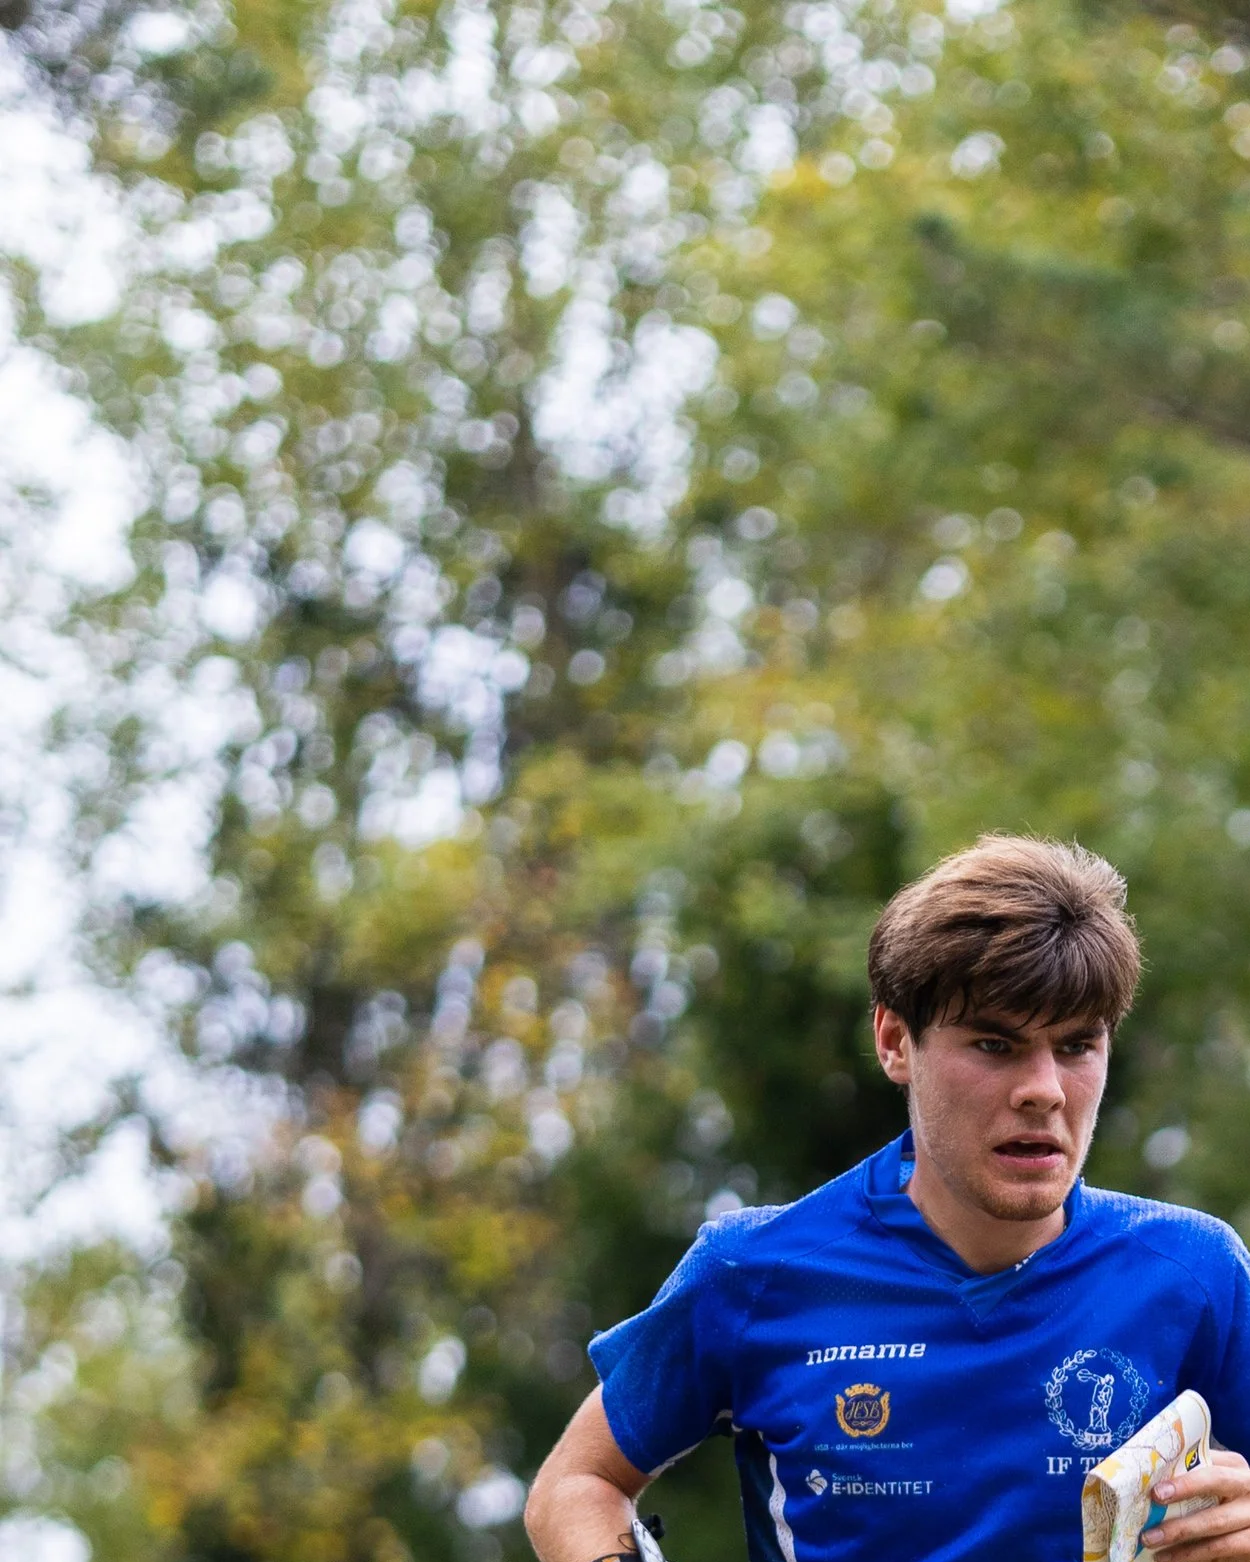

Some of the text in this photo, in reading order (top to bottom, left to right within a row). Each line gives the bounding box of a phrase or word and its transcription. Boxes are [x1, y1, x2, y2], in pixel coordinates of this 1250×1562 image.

[805, 1343, 927, 1366] noname
[1046, 1456, 1073, 1475] IF
[832, 1481, 934, 1495] E-IDENTITET
